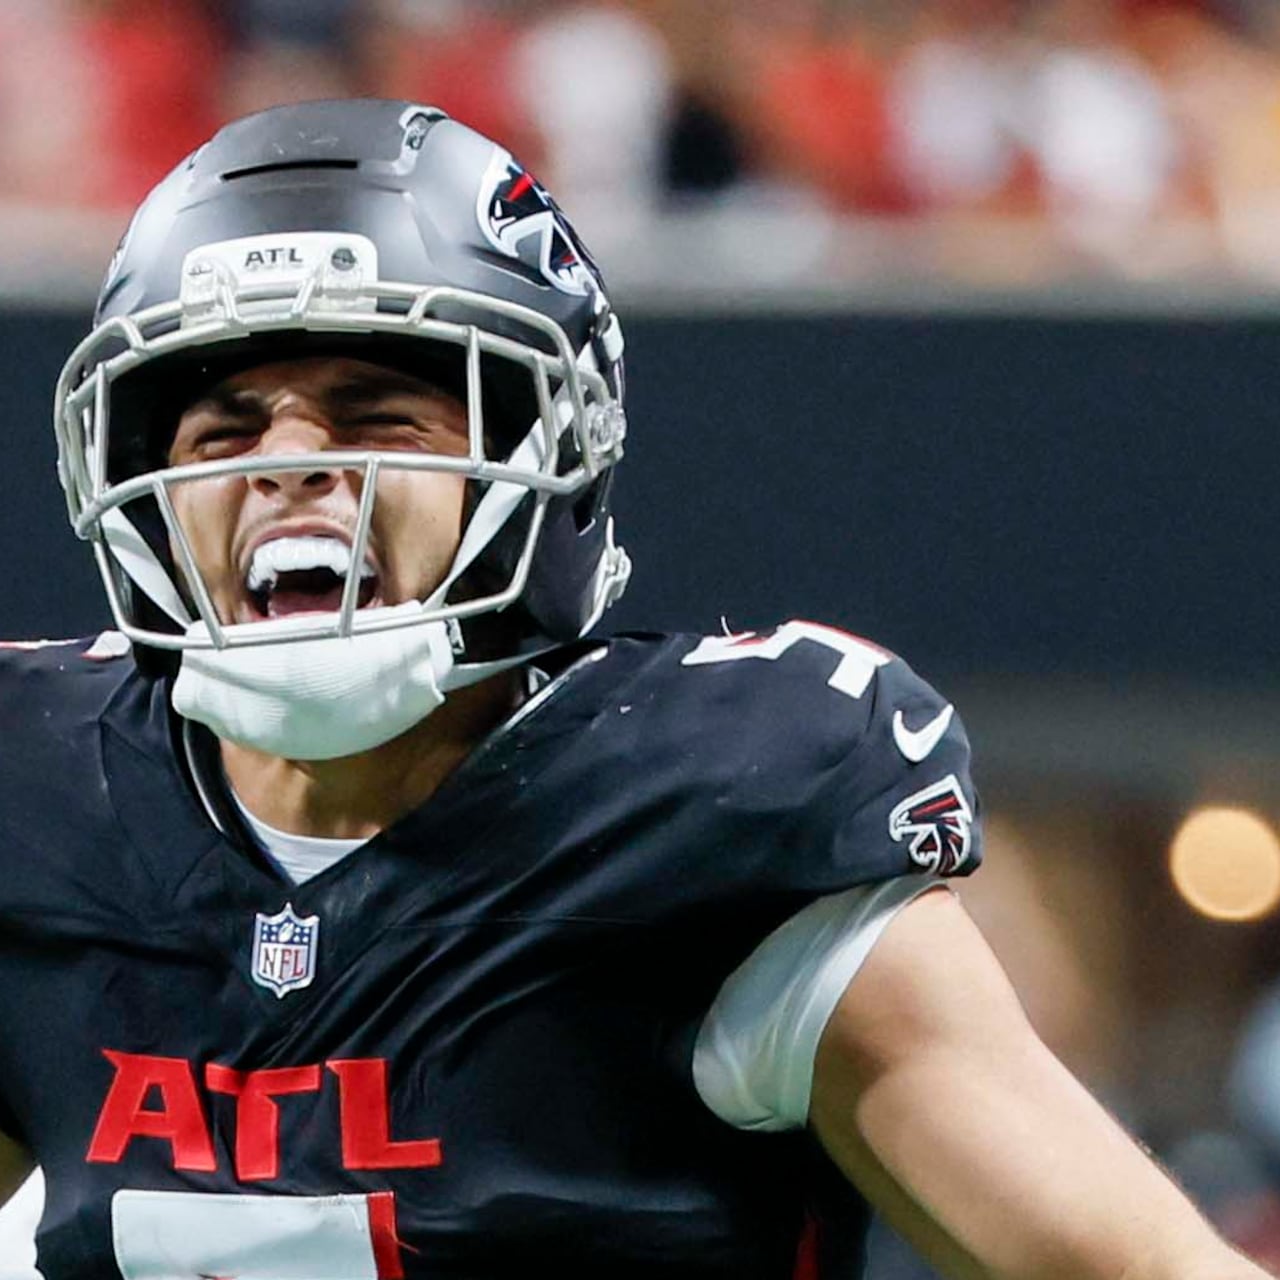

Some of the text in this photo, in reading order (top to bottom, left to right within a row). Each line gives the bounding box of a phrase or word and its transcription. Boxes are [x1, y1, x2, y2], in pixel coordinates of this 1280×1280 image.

[245, 247, 303, 267] ATL
[262, 947, 304, 981] NFL
[87, 1050, 442, 1180] ATL
